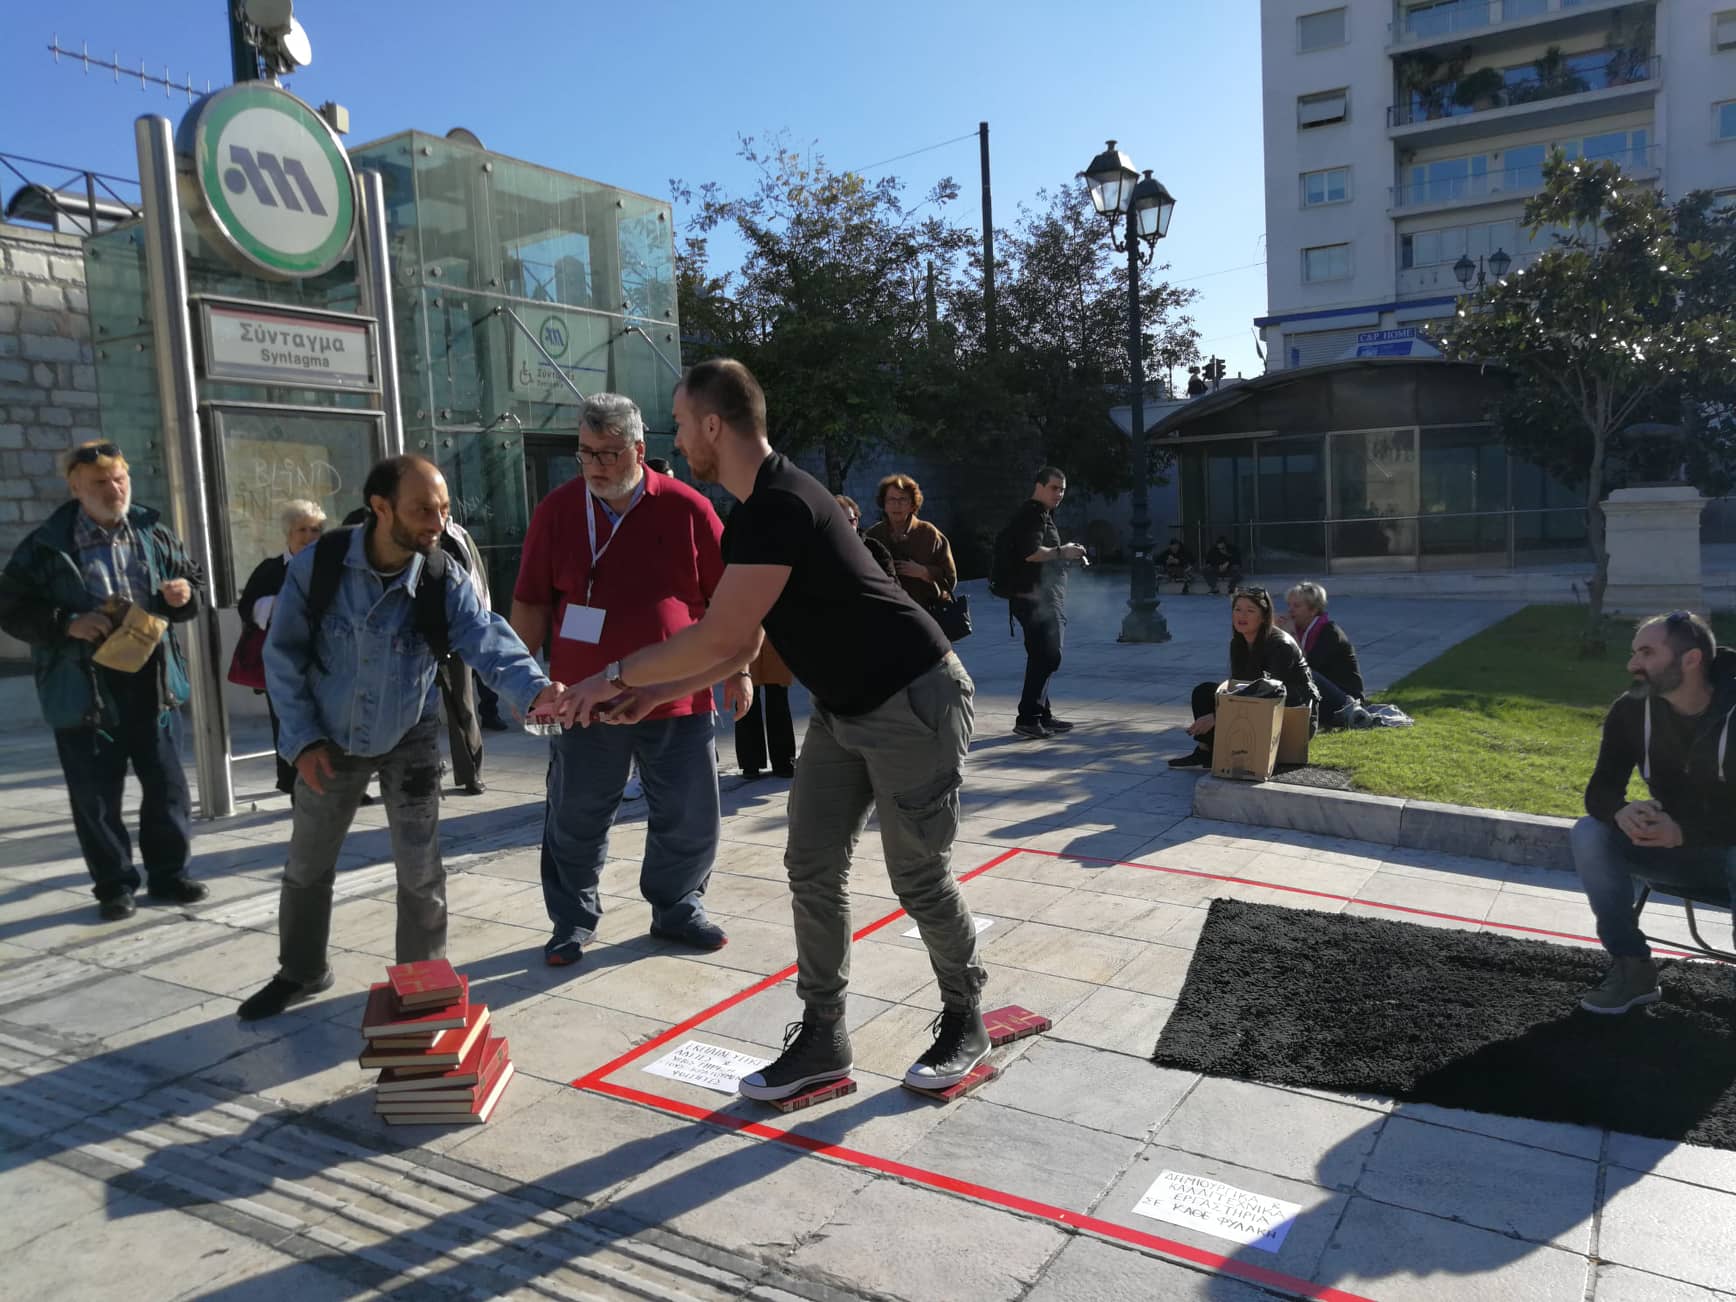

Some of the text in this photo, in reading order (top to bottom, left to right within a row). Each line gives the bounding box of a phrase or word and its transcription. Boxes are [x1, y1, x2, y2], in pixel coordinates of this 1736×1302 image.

[240, 321, 346, 353] Σύνταγμα
[261, 347, 330, 369] Syntagma
[1163, 1172, 1260, 1204] ΔΗΜΙΟΥΡΓΙΚΑ
[1168, 1183, 1286, 1220] ΚΑΛΛΙΤΕΧΝΙΚΑ
[1173, 1193, 1271, 1226] ΕΡΓΑΣΤΗΡΙΑ
